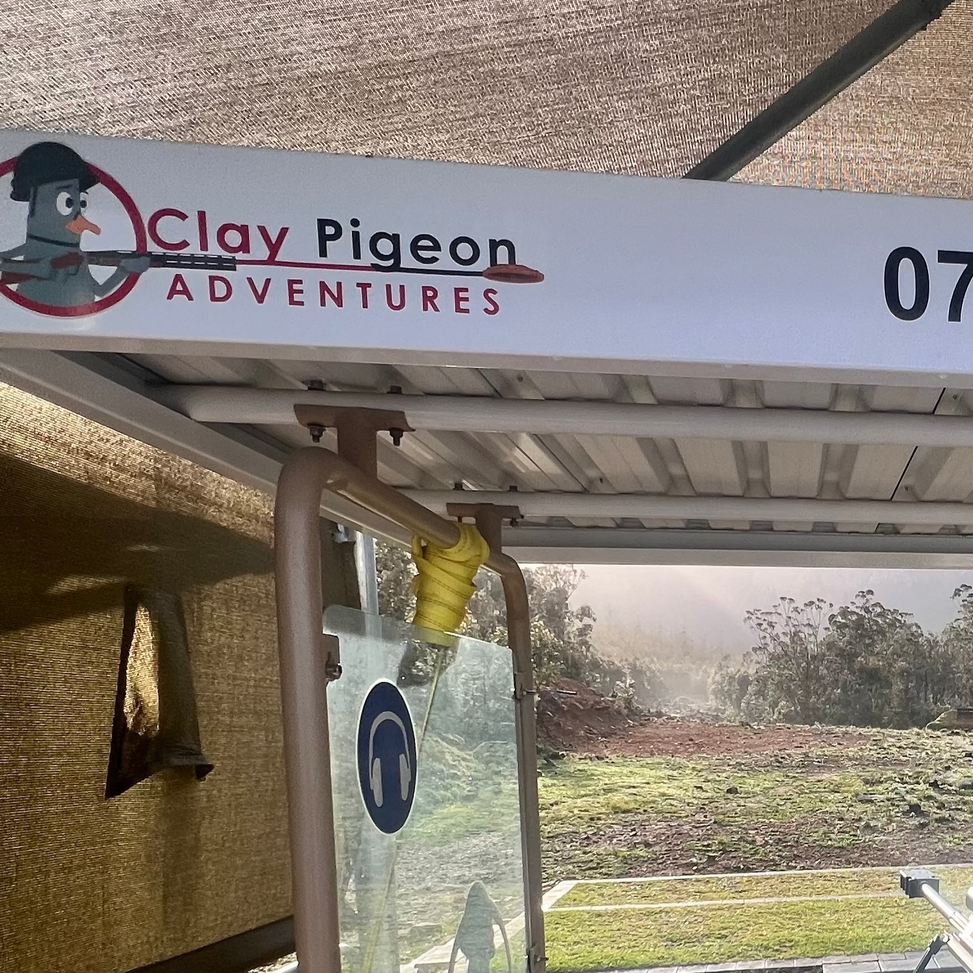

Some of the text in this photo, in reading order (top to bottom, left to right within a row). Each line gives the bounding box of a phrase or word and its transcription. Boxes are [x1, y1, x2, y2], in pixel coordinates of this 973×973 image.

[147, 207, 518, 272] Clay Pigeon
[166, 273, 501, 316] ADVENTURES
